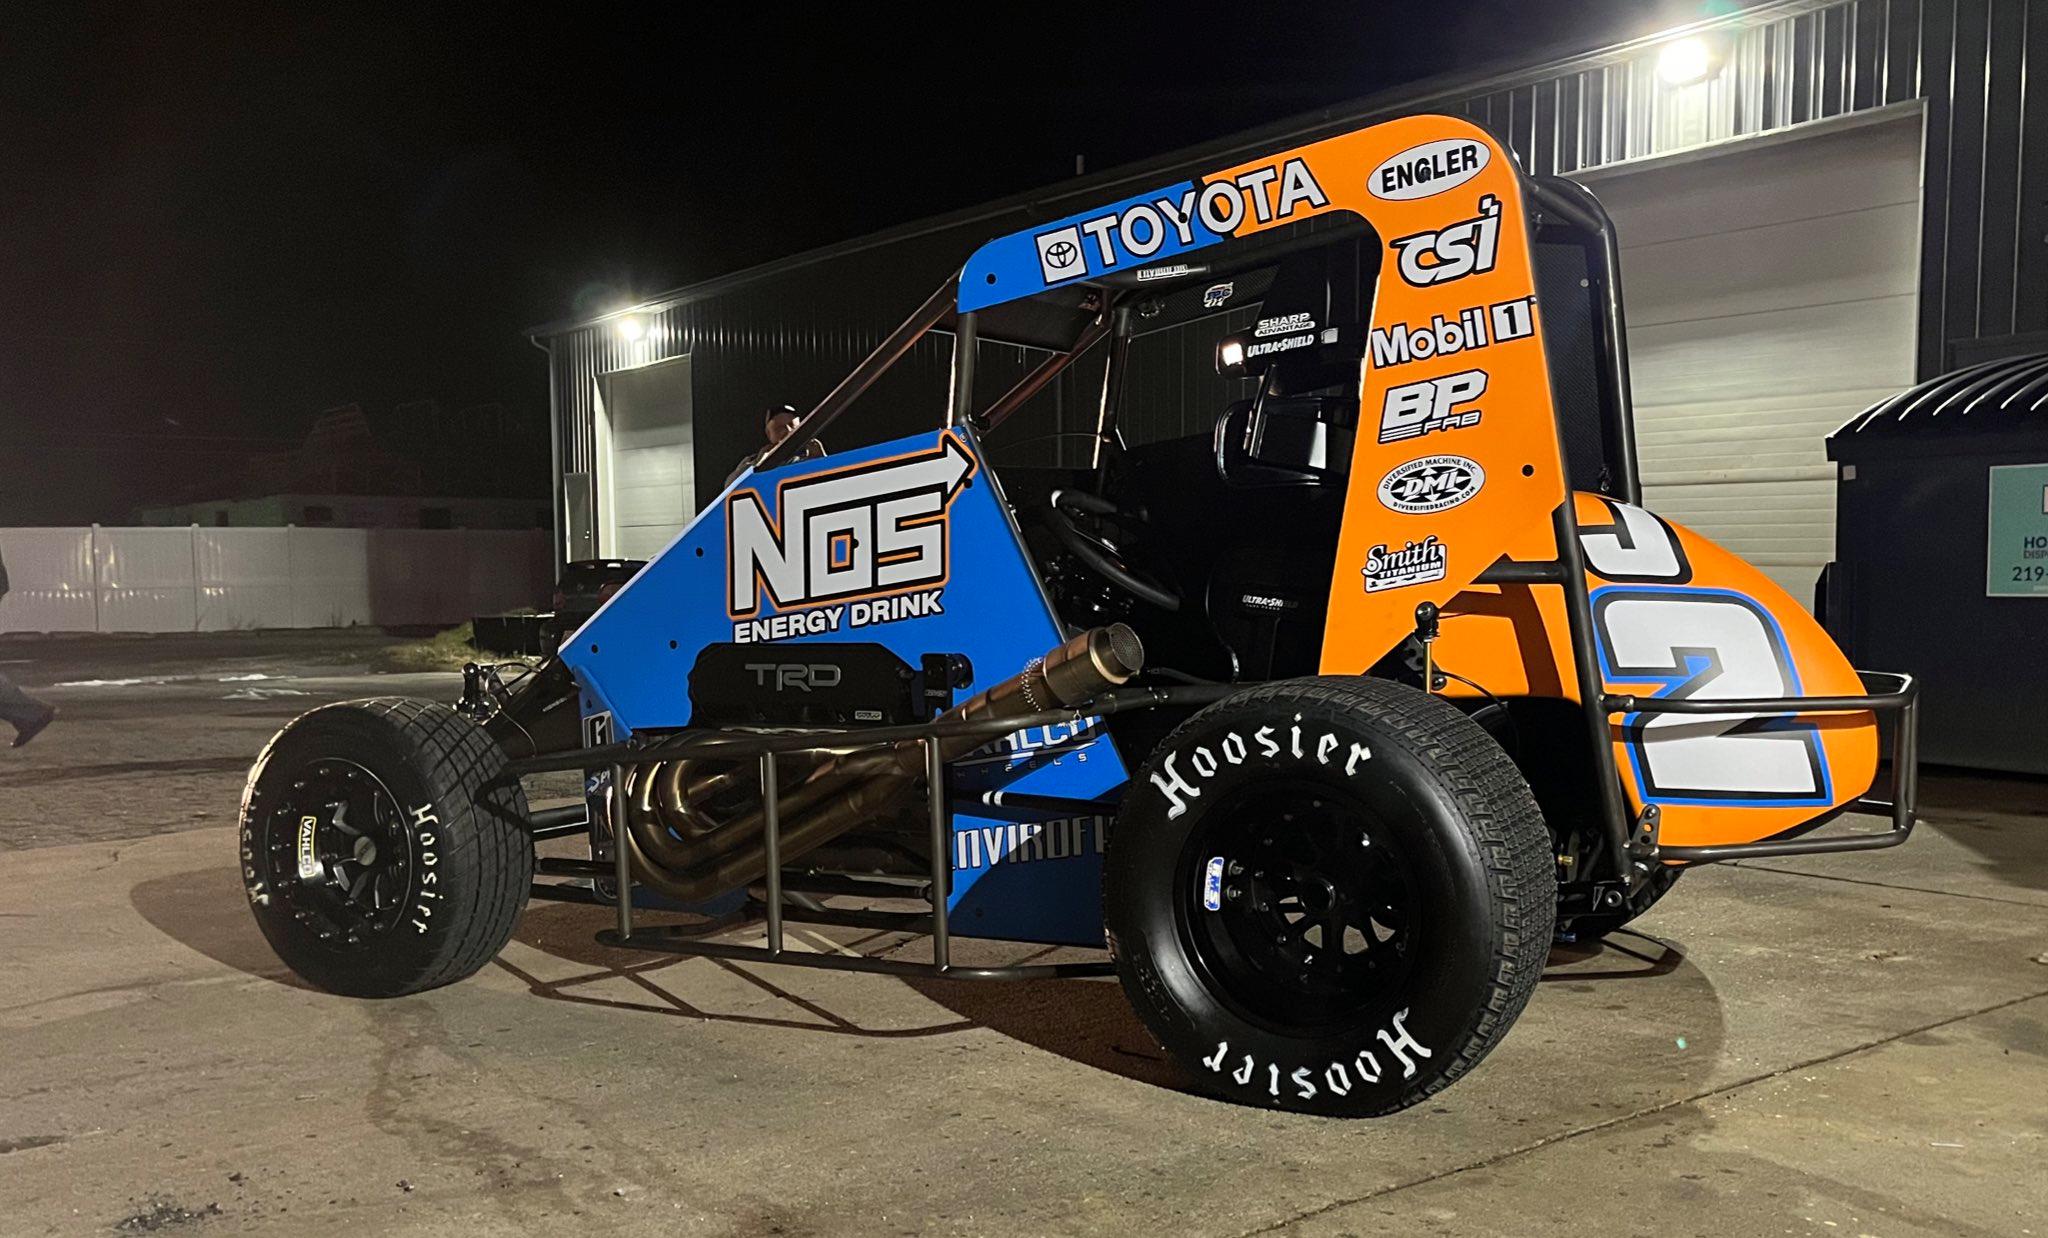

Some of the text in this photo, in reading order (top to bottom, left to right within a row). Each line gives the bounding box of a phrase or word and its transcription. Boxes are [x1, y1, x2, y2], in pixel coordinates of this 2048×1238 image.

[1381, 144, 1479, 194] ENGLER
[1082, 159, 1326, 266] TOYOTA
[1257, 321, 1313, 337] ADVANTAGE
[1258, 312, 1311, 330] SHARP
[1371, 307, 1488, 368] Mobil
[1382, 370, 1488, 430] BP
[1423, 410, 1481, 433] FAB
[1382, 461, 1424, 490] DIVERSIFIED
[1424, 456, 1462, 467] MACHINE
[1401, 467, 1460, 498] DMI
[731, 444, 968, 612] NOS
[1361, 535, 1440, 577] Smith
[1378, 560, 1442, 579] TITANIUM
[734, 590, 943, 643] ENERGY DRINK
[744, 663, 842, 692] TRD
[1598, 596, 1822, 797] 2
[1150, 712, 1372, 821] Hoosier
[301, 818, 315, 875] VAHLCO
[407, 802, 443, 935] Hoosier
[1201, 1006, 1433, 1104] Hoosier
